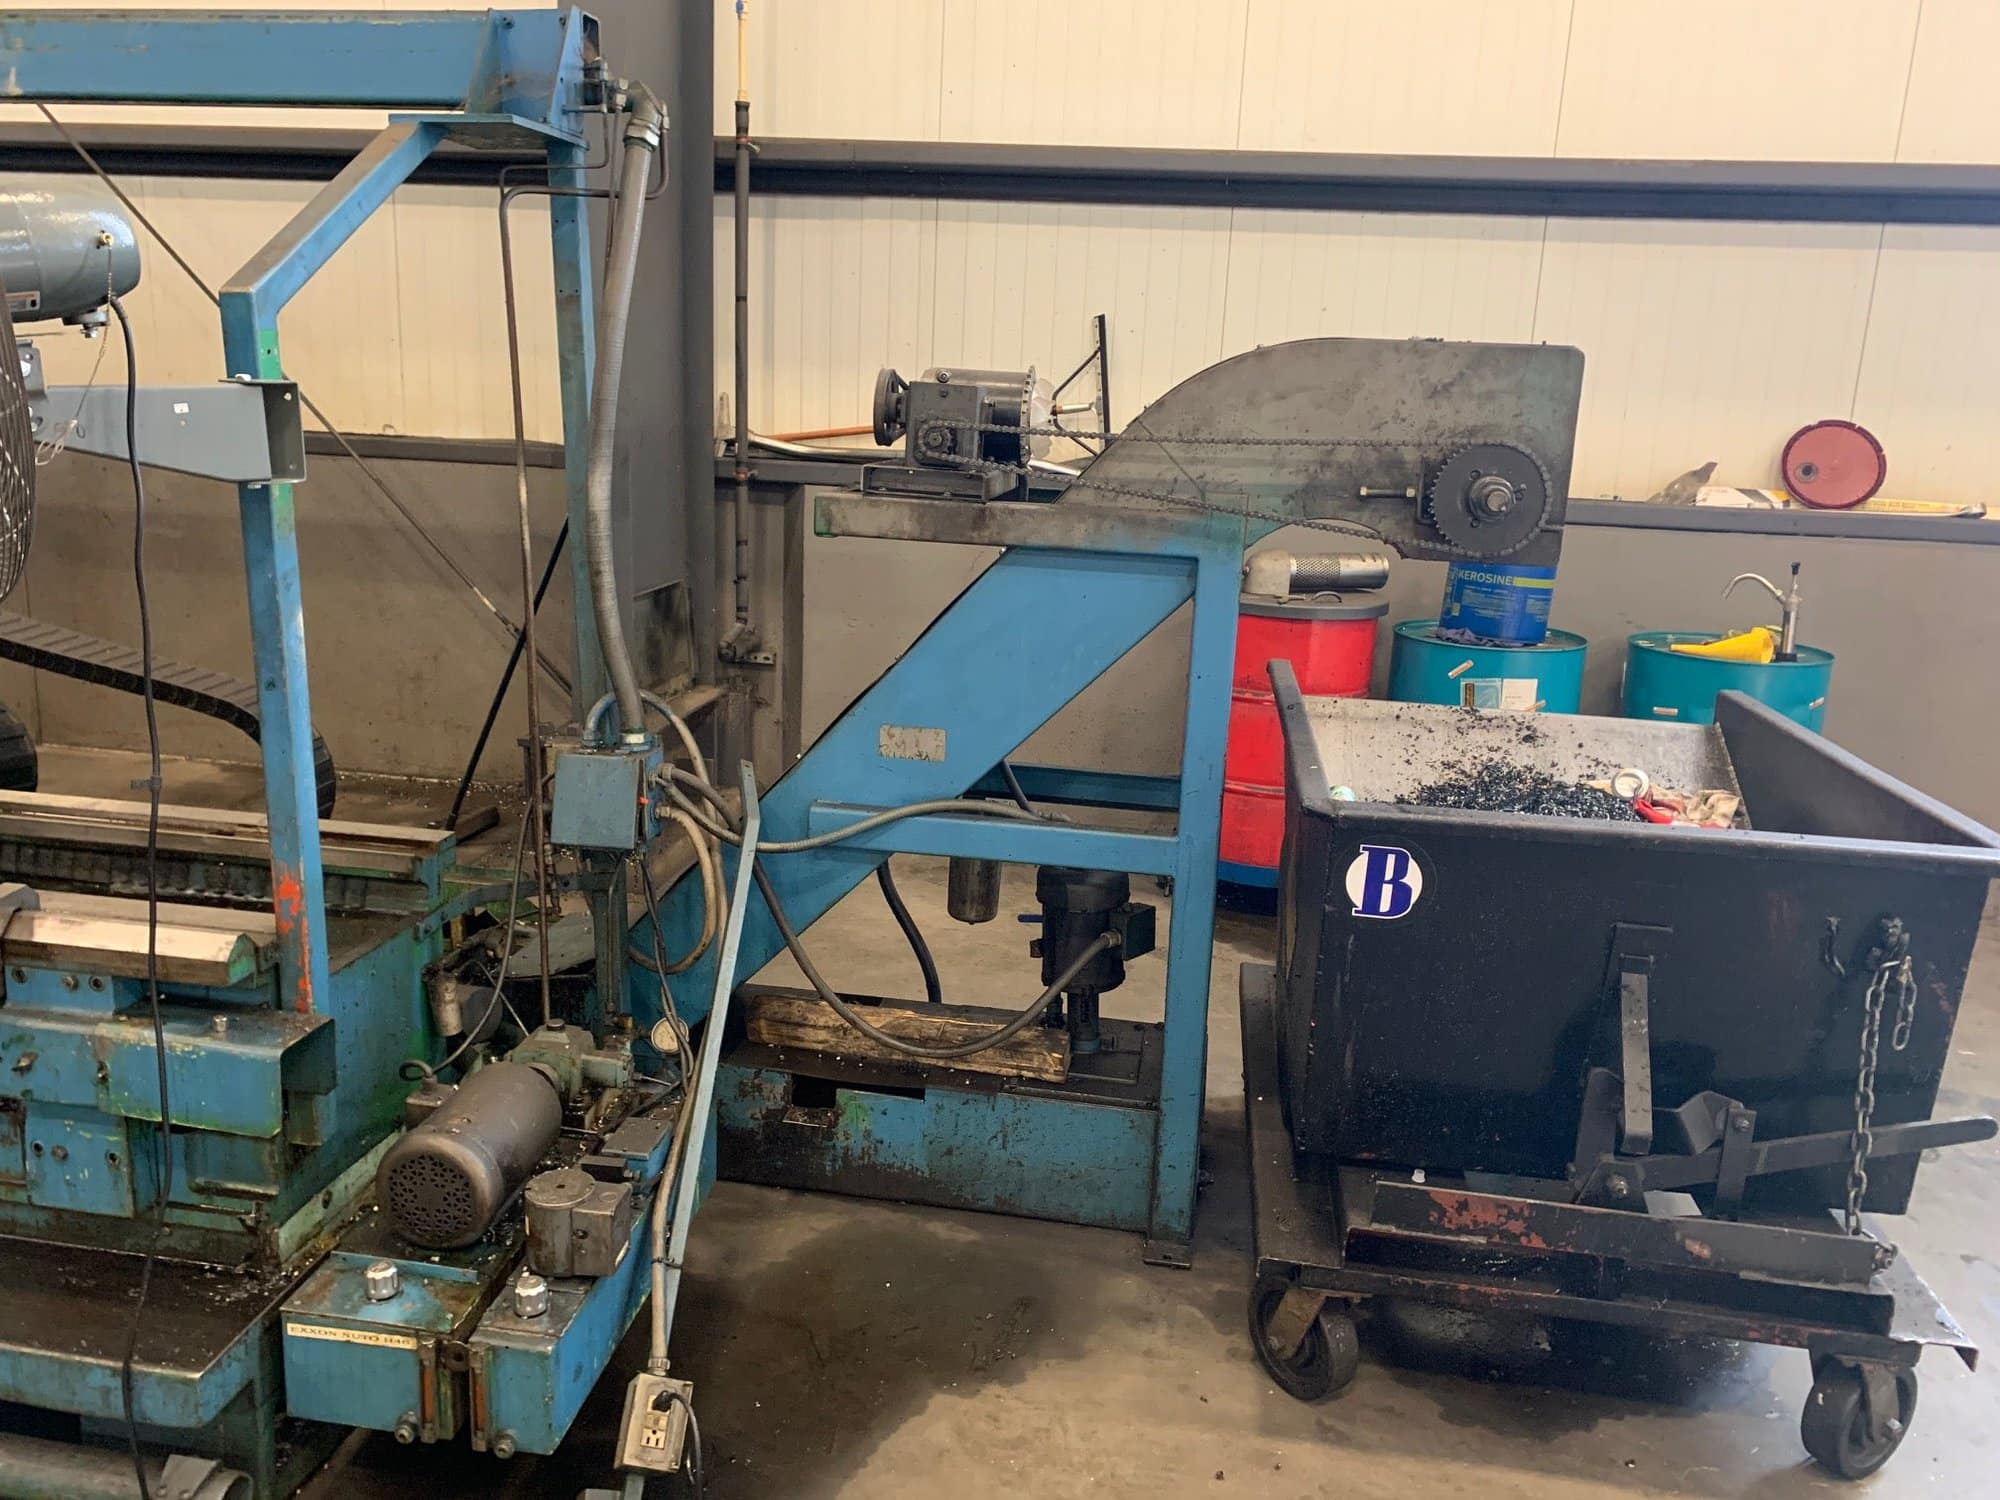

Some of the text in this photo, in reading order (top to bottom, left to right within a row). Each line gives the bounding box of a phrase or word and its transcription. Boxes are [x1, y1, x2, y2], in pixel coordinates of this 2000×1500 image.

[1458, 569, 1514, 586] KEROSINE
[1352, 844, 1413, 919] B
[289, 1325, 337, 1338] EXXON
